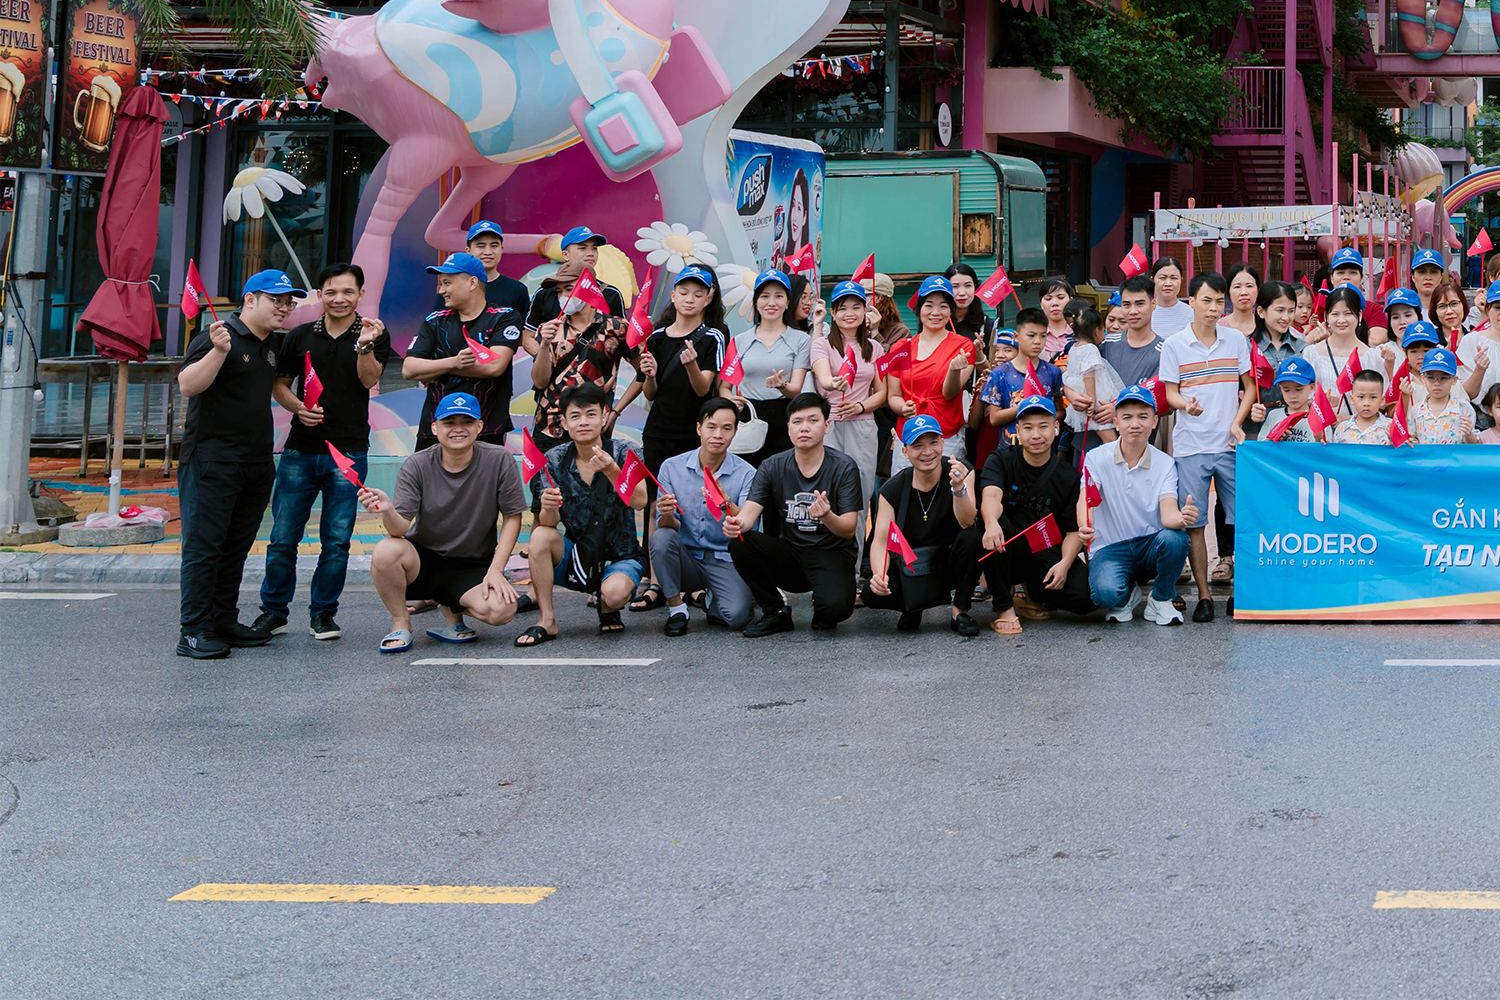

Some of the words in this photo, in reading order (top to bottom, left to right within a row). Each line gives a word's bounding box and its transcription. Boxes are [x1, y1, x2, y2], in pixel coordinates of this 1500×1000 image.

[84, 11, 126, 39] BEER
[74, 40, 133, 66] FESTIVAL
[743, 163, 765, 204] push
[748, 183, 765, 208] max
[1210, 210, 1247, 224] HÀNG
[1431, 498, 1489, 530] GẮN
[1258, 533, 1378, 554] MODERO
[1258, 557, 1295, 566] Shine
[1303, 558, 1332, 568] your
[1339, 557, 1375, 566] home
[1422, 543, 1475, 573] TẠO
